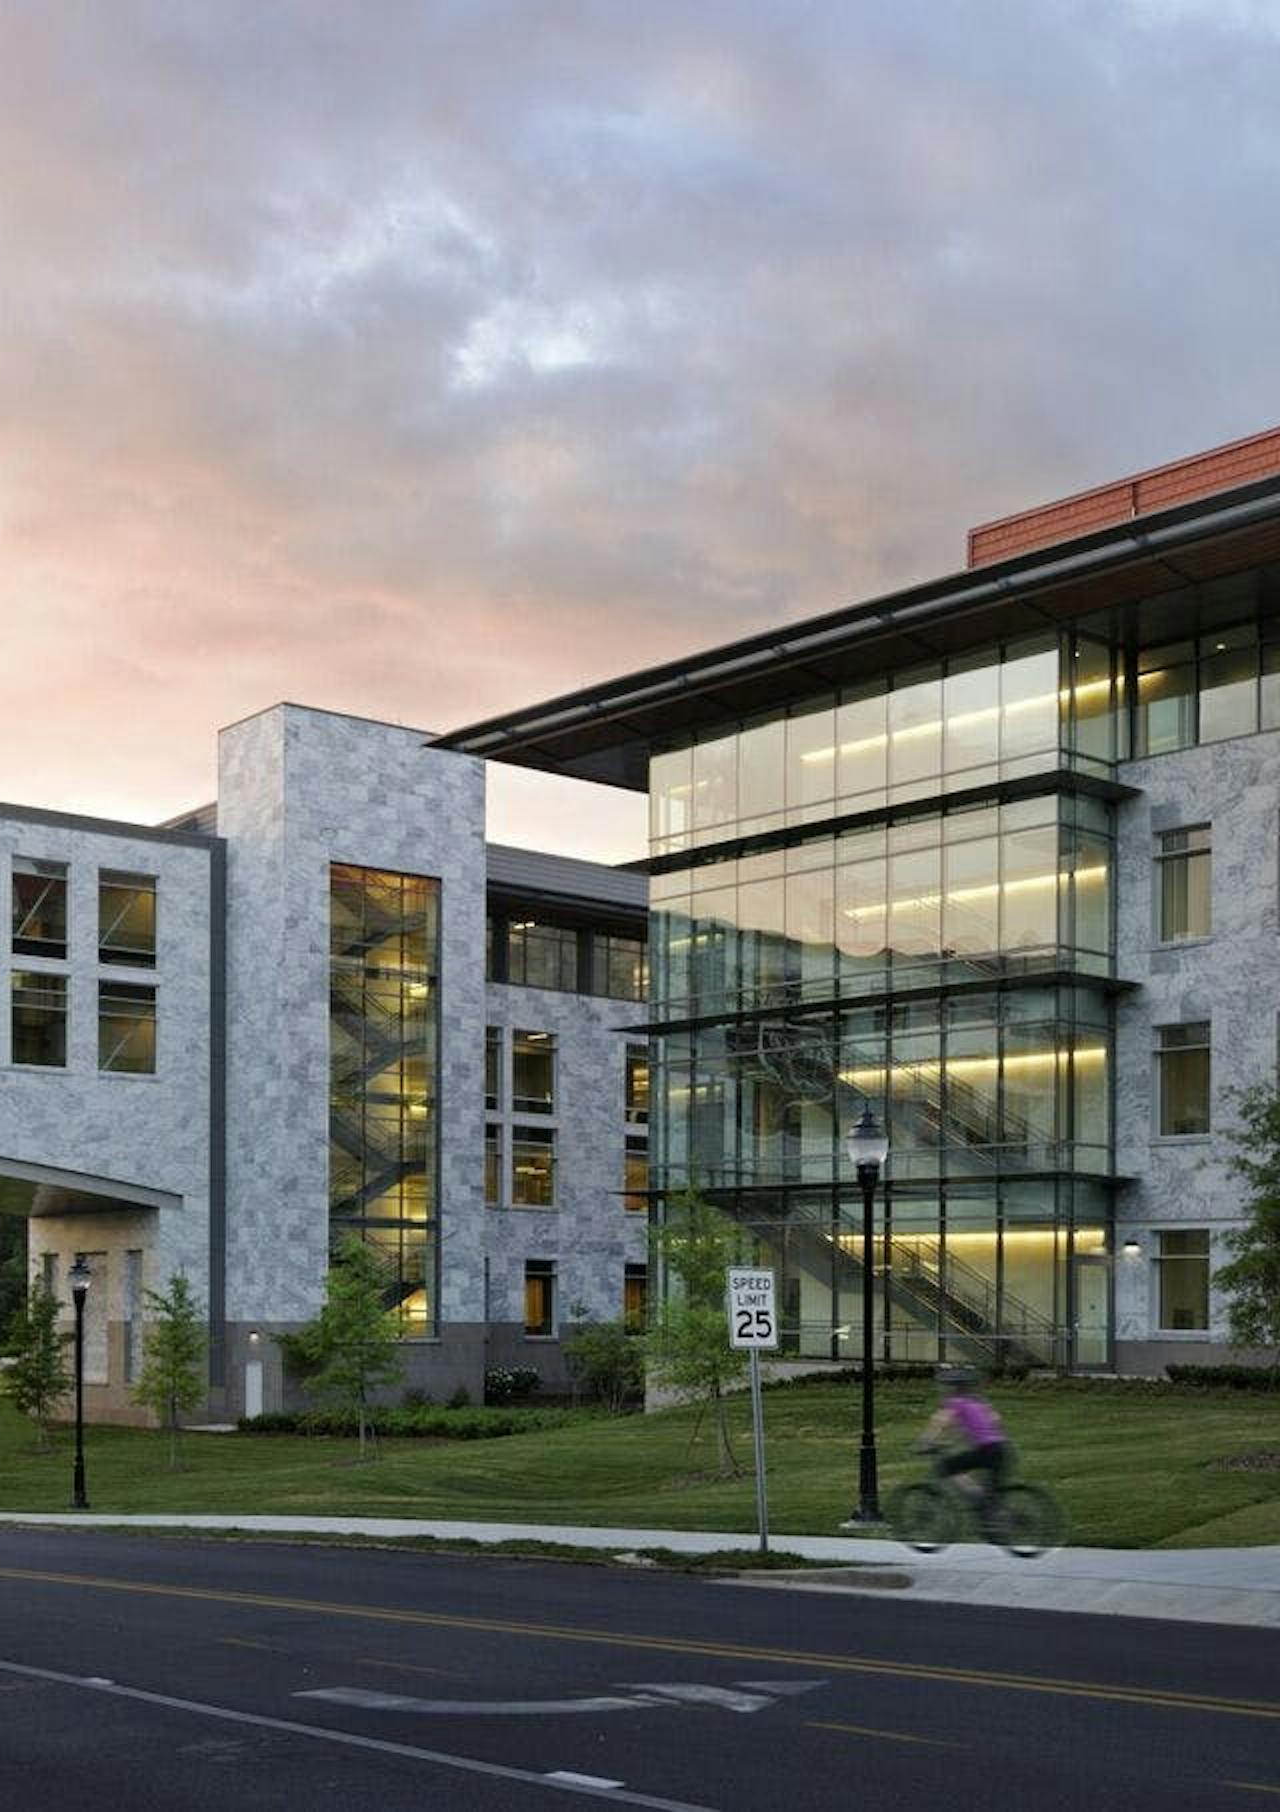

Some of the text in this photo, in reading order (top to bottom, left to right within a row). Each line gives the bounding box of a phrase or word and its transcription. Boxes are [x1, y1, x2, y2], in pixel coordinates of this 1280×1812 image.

[732, 1277, 771, 1290] SPEED
[737, 1294, 767, 1306] LIMIT
[736, 1310, 772, 1338] 25
